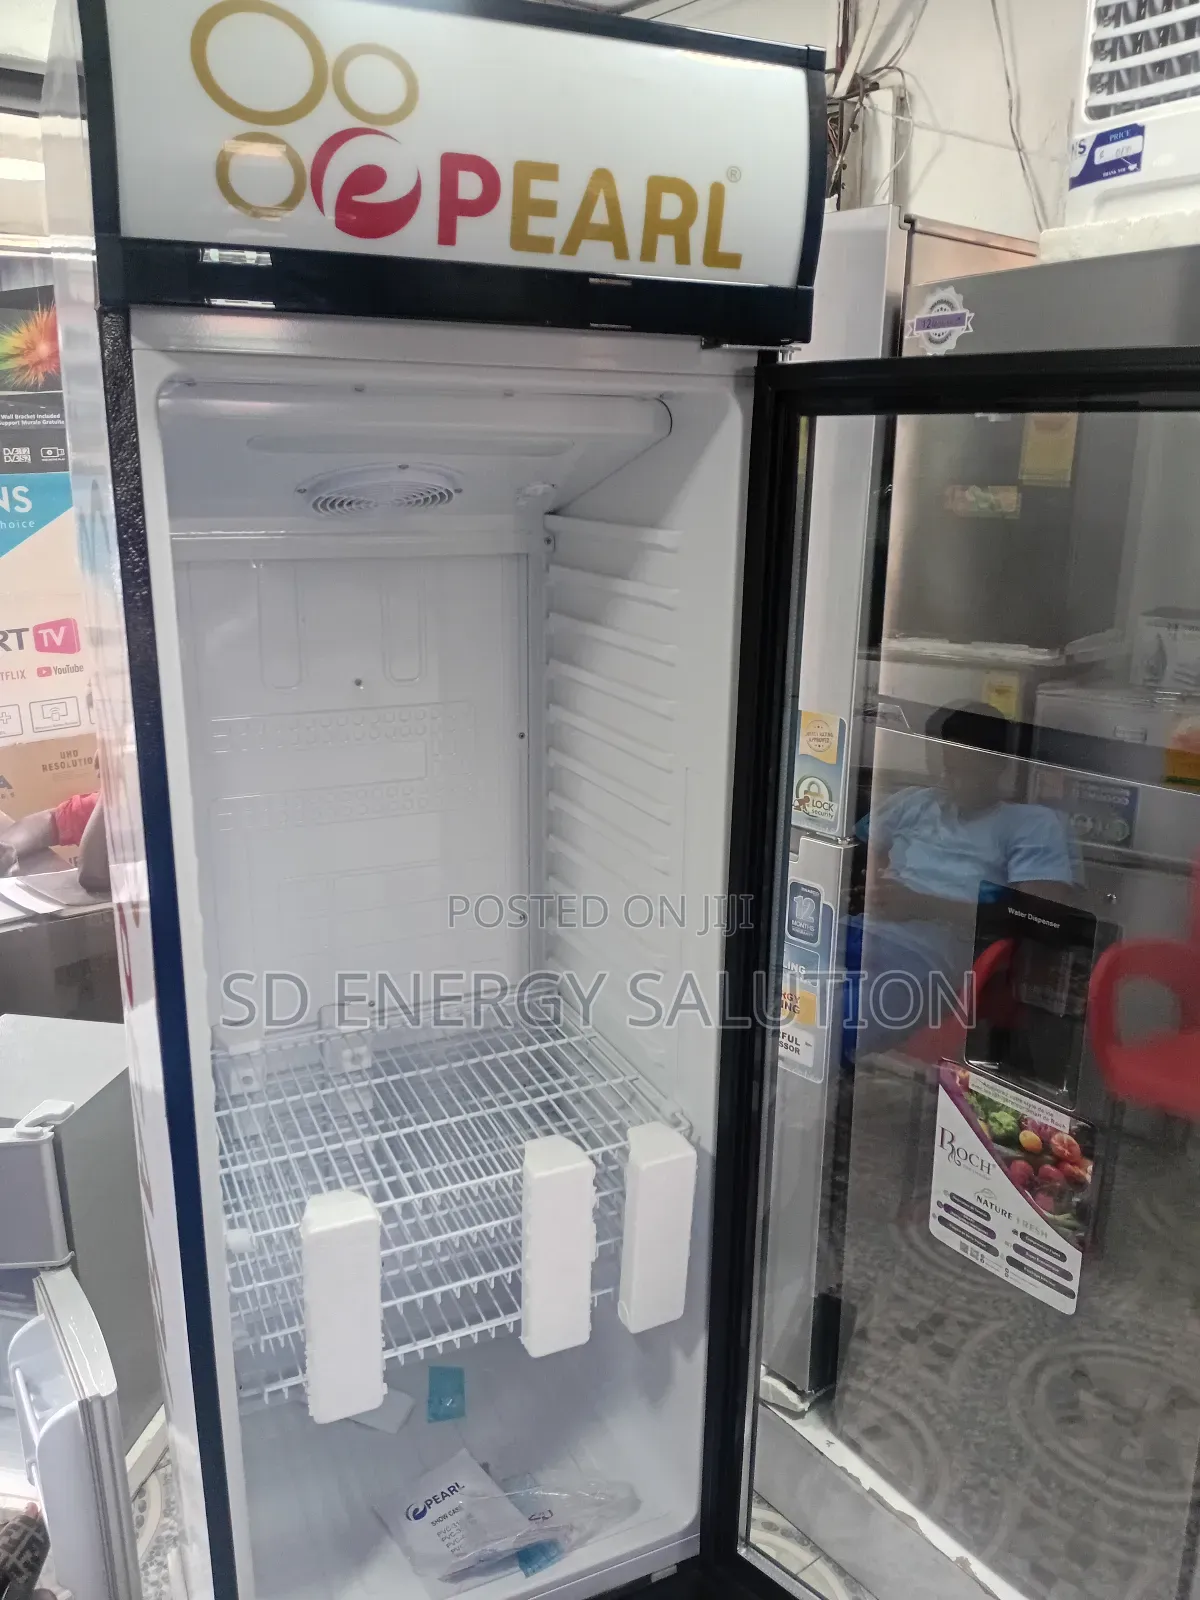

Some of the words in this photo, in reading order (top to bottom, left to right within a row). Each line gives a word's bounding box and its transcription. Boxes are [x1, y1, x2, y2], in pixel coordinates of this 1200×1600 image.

[437, 151, 743, 270] PEARL
[38, 626, 67, 648] TV
[53, 664, 84, 676] YouTube
[42, 757, 93, 773] RESOLUTIO
[812, 799, 834, 812] LOCK
[793, 895, 816, 923] 12
[1008, 906, 1028, 919] Water
[1028, 913, 1060, 930] Dispenser
[791, 919, 815, 932] MONTHS
[780, 1031, 801, 1046] FUL
[976, 1195, 1014, 1221] NATURE
[425, 1482, 464, 1509] PEARL
